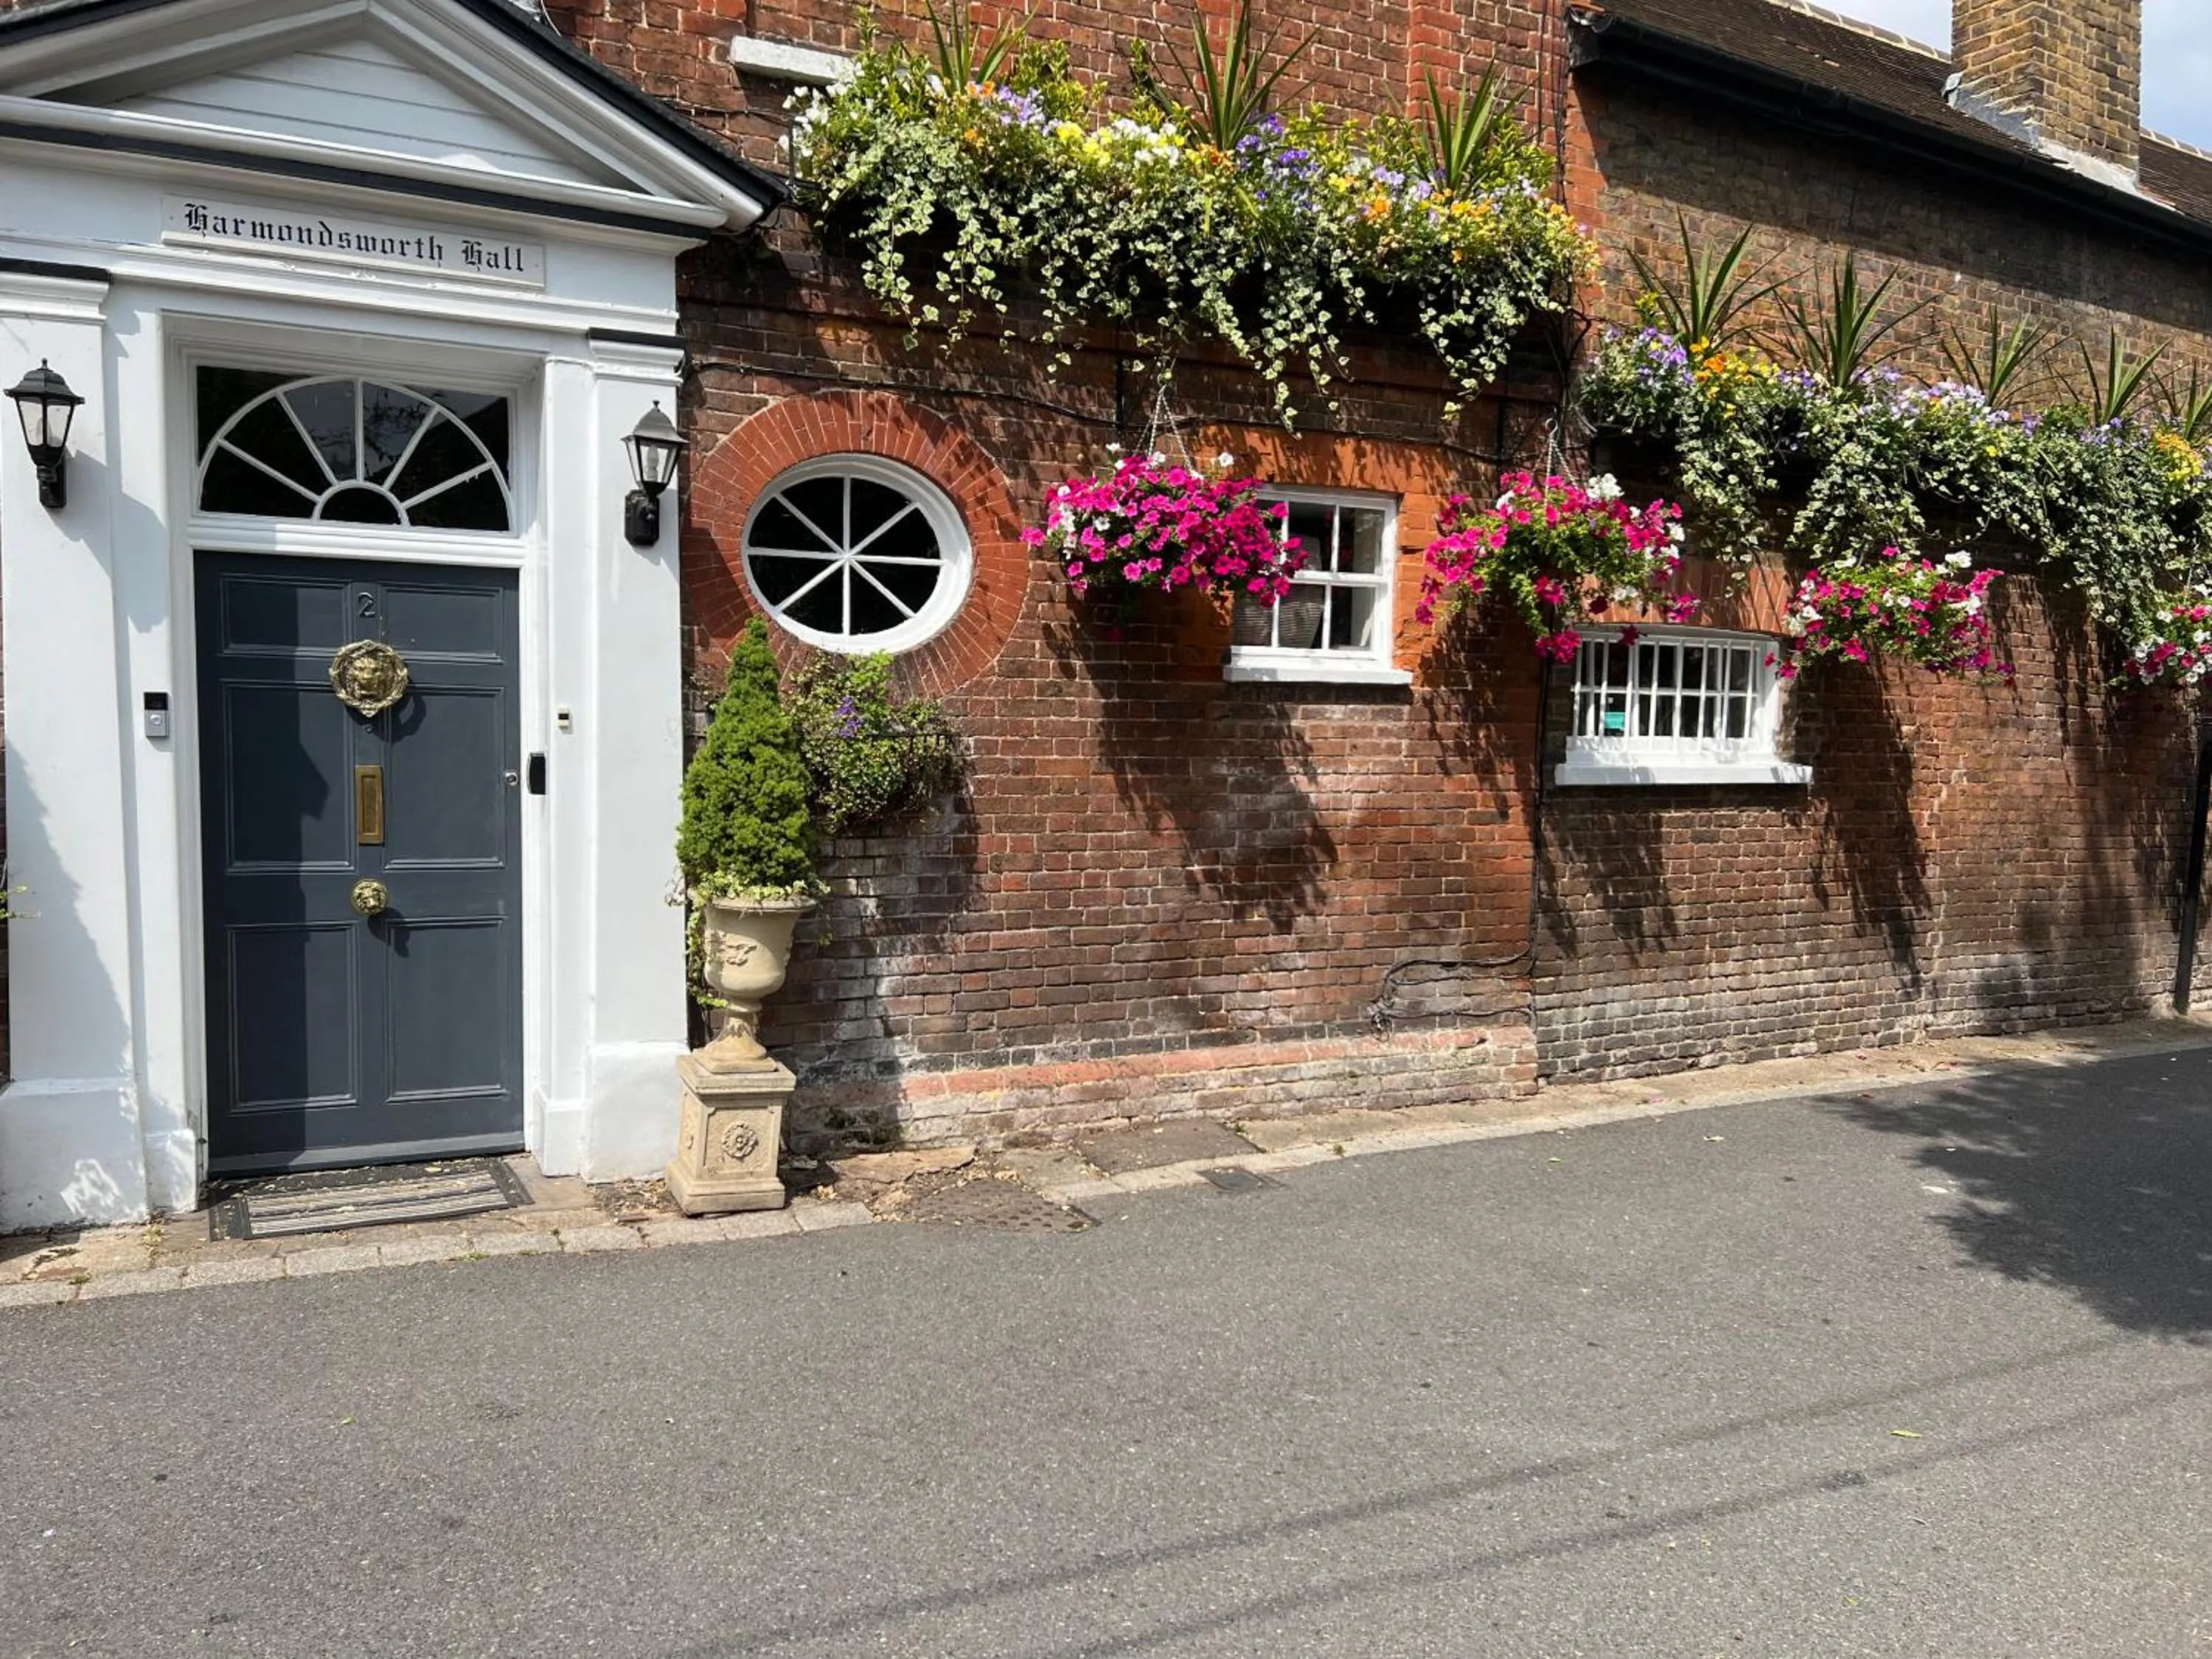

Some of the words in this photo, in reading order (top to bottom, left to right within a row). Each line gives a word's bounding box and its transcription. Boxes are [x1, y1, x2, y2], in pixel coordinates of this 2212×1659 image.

[184, 203, 443, 268] Harmondsworth
[462, 240, 524, 271] Hall
[357, 592, 375, 618] 2
